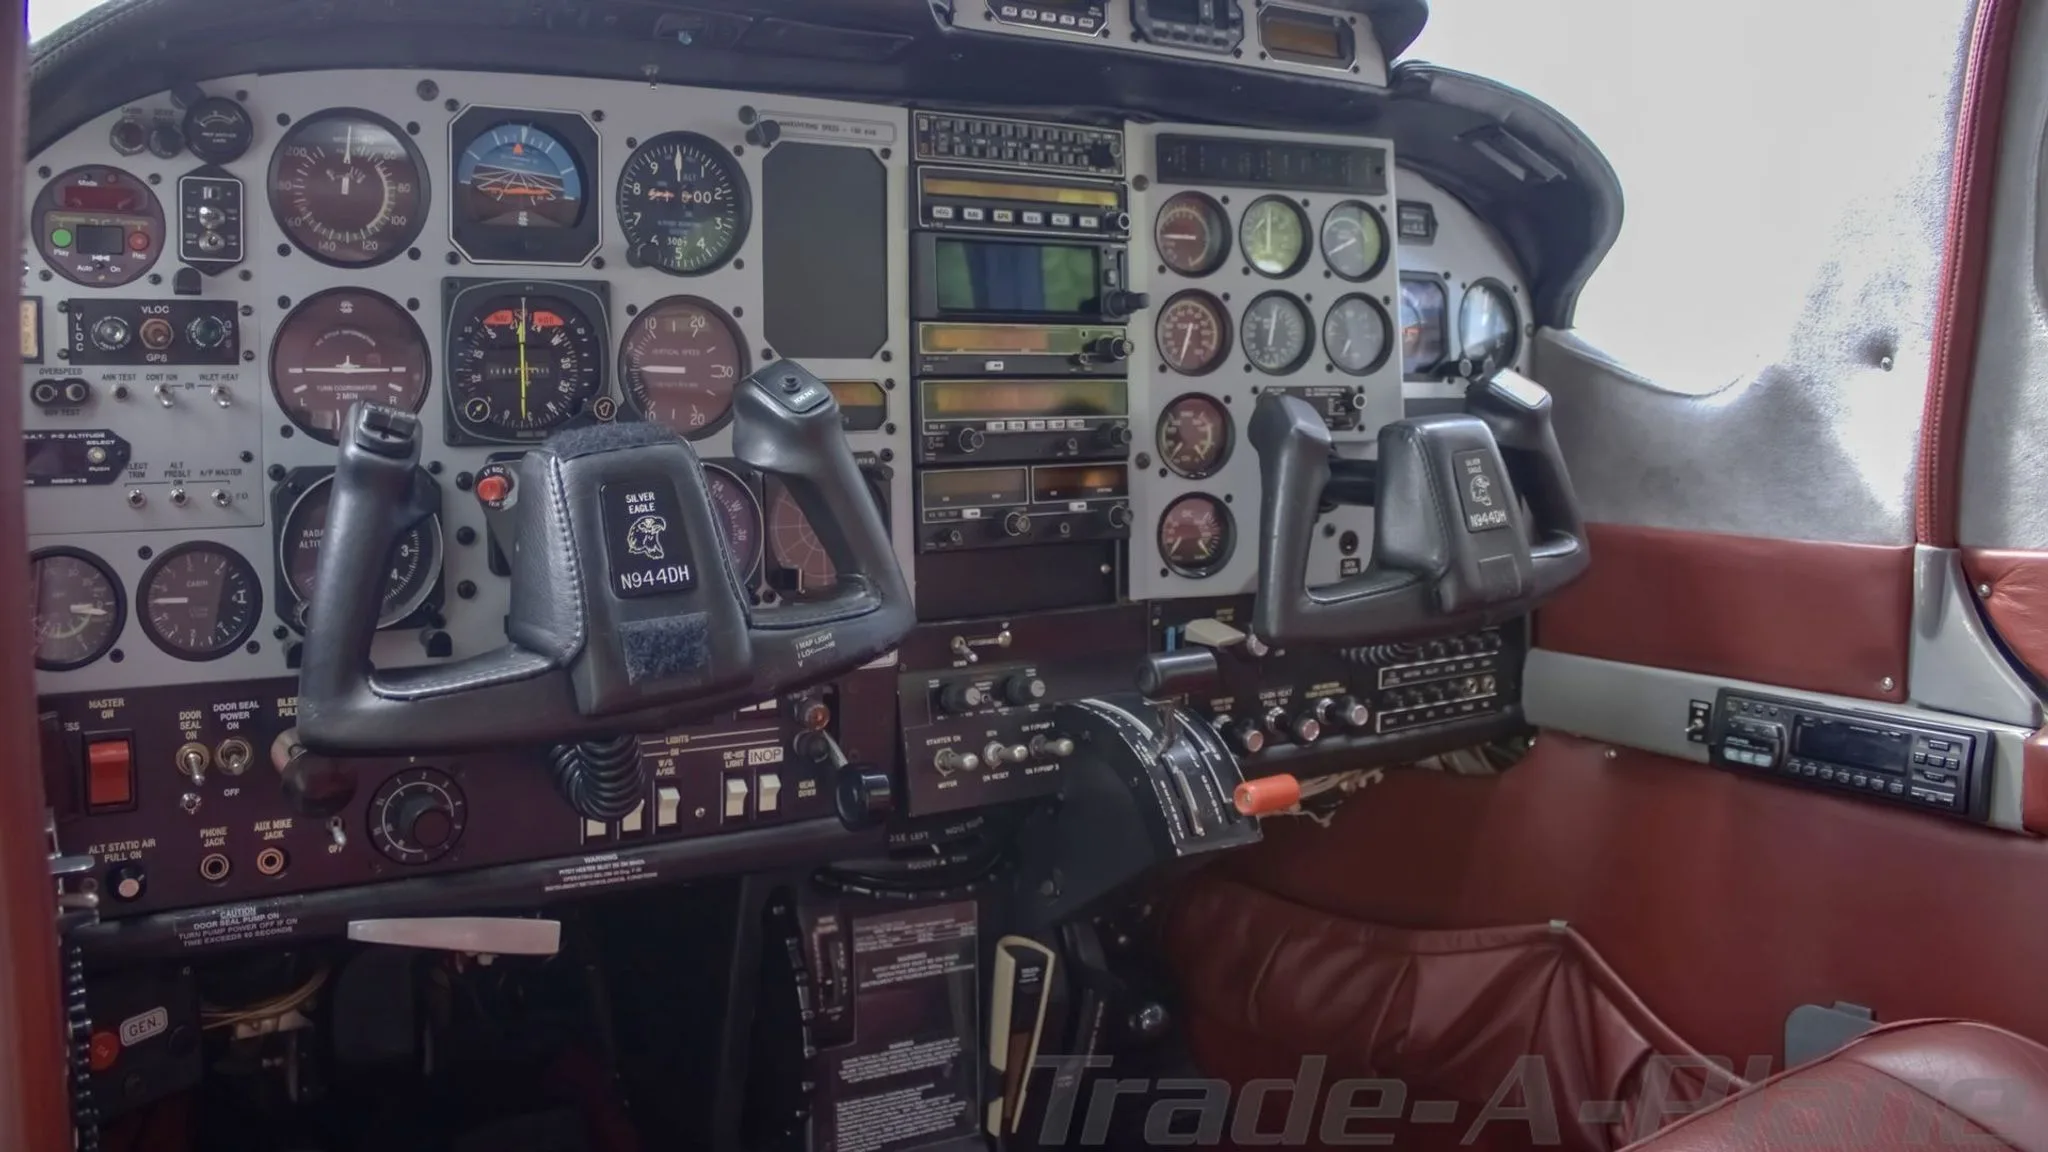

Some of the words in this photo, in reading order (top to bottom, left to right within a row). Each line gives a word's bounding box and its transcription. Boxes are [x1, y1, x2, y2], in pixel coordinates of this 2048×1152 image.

[650, 162, 658, 175] 9
[398, 183, 410, 192] 80
[632, 182, 642, 196] 8
[714, 187, 722, 200] 2
[391, 216, 406, 226] 100
[632, 212, 642, 226] 7
[714, 216, 722, 230] 3
[318, 242, 336, 251] 140
[362, 241, 378, 250] 120
[696, 237, 706, 250] 4
[54, 249, 70, 258] Play
[675, 248, 683, 260] 5
[76, 264, 93, 273] Auto
[110, 266, 121, 274] On
[141, 305, 170, 314] VLOC
[644, 316, 656, 330] 10
[690, 316, 705, 329] 20
[146, 353, 168, 363] GPS
[38, 368, 82, 376] OVERSPEED
[720, 366, 734, 378] 30
[102, 374, 116, 382] ANN
[118, 374, 136, 382] TEST
[198, 374, 218, 382] INLET
[221, 374, 239, 382] HEAT
[342, 392, 358, 400] MIN
[389, 396, 397, 404] R
[690, 412, 705, 426] 20
[68, 432, 106, 440] ALTITUDE
[1464, 457, 1481, 468] SILVER
[215, 469, 242, 477] MASTER
[625, 492, 656, 504] SILVER
[628, 502, 656, 514] EAGLE
[1469, 510, 1506, 528] N944DH
[400, 544, 408, 557] 3
[391, 568, 398, 580] 4
[620, 564, 690, 590] N944DH
[88, 698, 125, 710] MASTER
[213, 702, 237, 712] DOOR
[238, 700, 260, 710] SEAL
[102, 710, 114, 720] ON
[179, 711, 202, 720] DOOR
[220, 711, 250, 720] POWER
[180, 720, 202, 730] SEAL
[226, 721, 240, 730] ON
[185, 731, 198, 740] ON
[664, 734, 690, 744] LIGHTS
[926, 736, 951, 746] STARTER
[750, 748, 782, 763] INOP
[726, 759, 744, 768] LIGHT
[992, 771, 1010, 782] RESET
[224, 788, 240, 797] OFF
[254, 820, 271, 832] AUX
[272, 818, 293, 830] MIKE
[200, 826, 228, 838] PHONE
[262, 830, 285, 841] JACK
[88, 844, 106, 855] ALT
[108, 840, 140, 852] STATIC
[142, 838, 156, 849] AIR
[204, 838, 226, 848] JACK
[104, 852, 128, 863] PULL
[130, 850, 142, 860] ON
[220, 906, 257, 920] CAUTION
[193, 920, 218, 931] DOOR
[219, 918, 242, 928] SEAL
[242, 914, 266, 924] PUMP
[266, 912, 280, 920] ON
[286, 918, 298, 926] ON
[128, 1016, 162, 1038] GEN.
